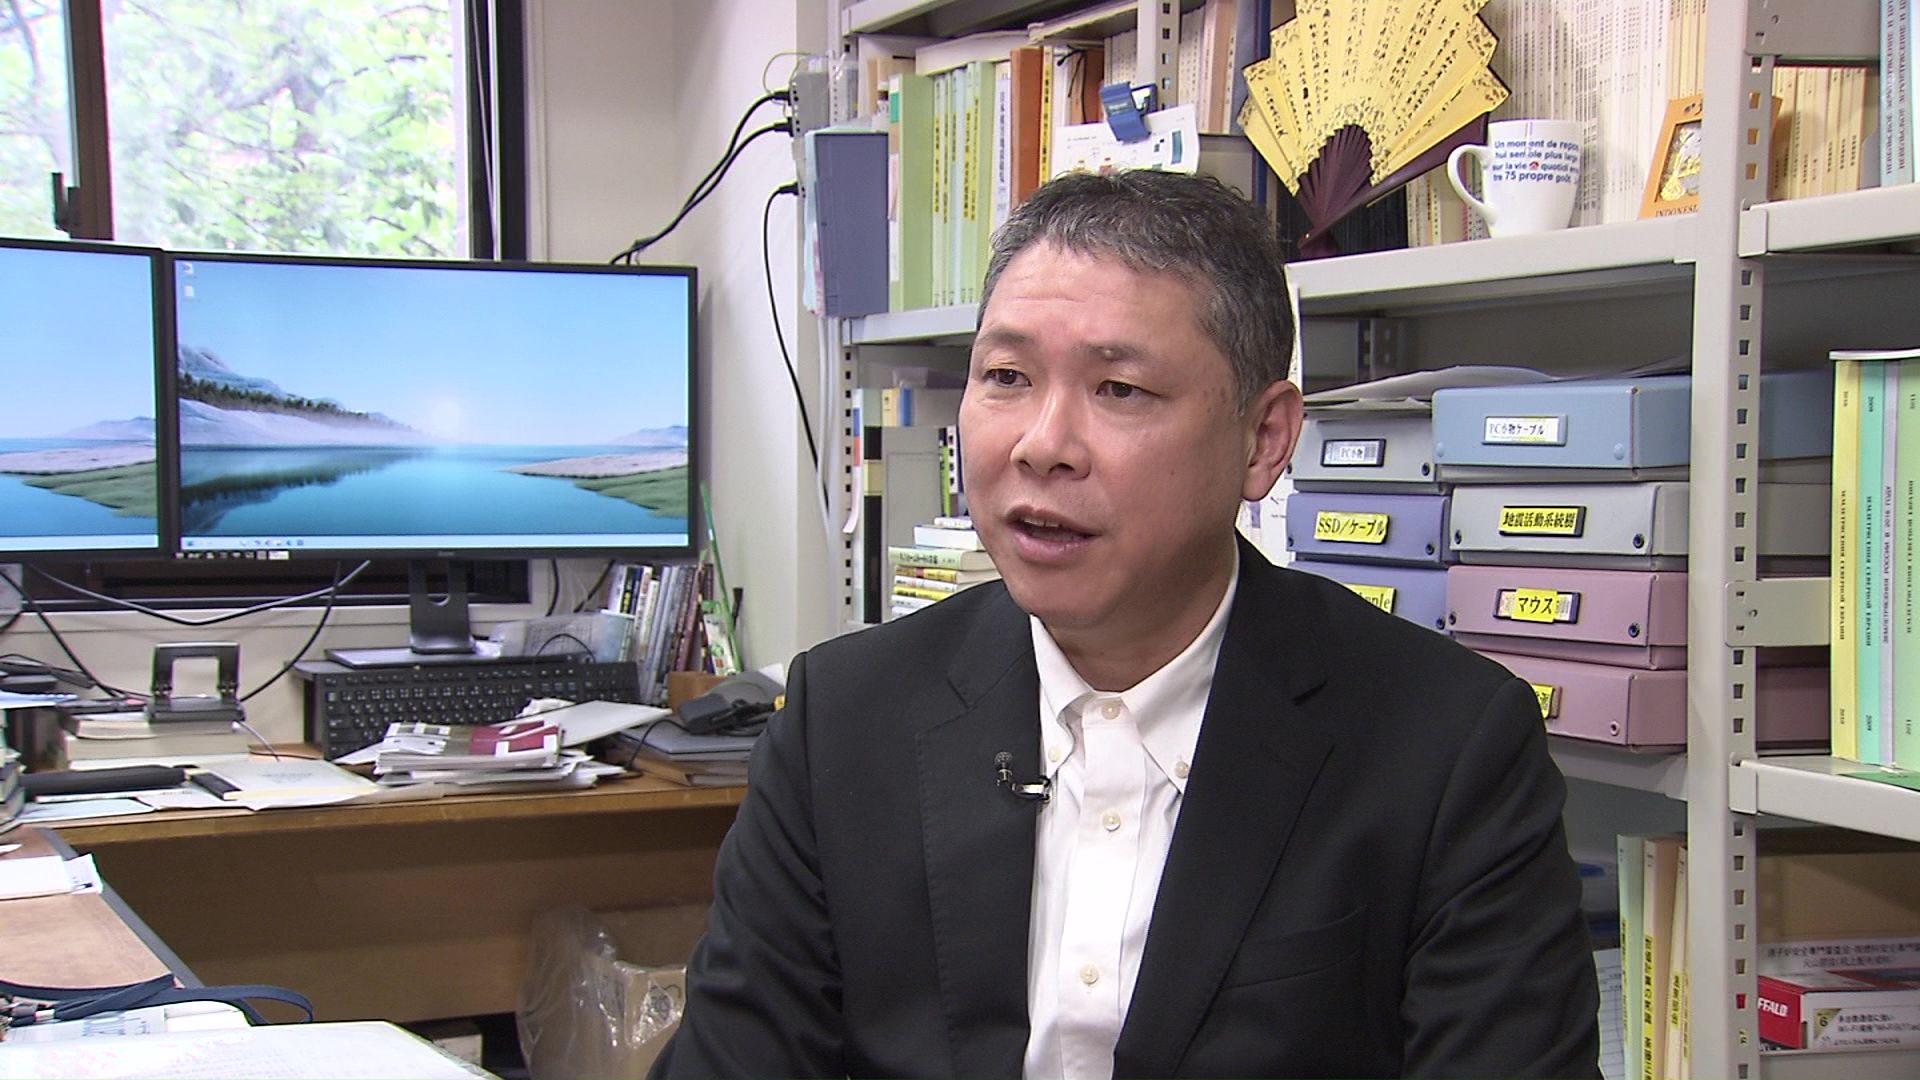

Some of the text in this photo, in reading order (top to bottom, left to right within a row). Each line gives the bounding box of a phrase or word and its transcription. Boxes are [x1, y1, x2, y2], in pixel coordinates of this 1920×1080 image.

[1546, 140, 1557, 148] de
[1544, 152, 1563, 161] plus
[1505, 162, 1513, 170] la
[1515, 162, 1527, 170] vie
[1505, 171, 1517, 180] 75
[1519, 172, 1554, 183] propre
[1518, 595, 1553, 614] マウス
[1818, 1016, 1828, 1027] 6
